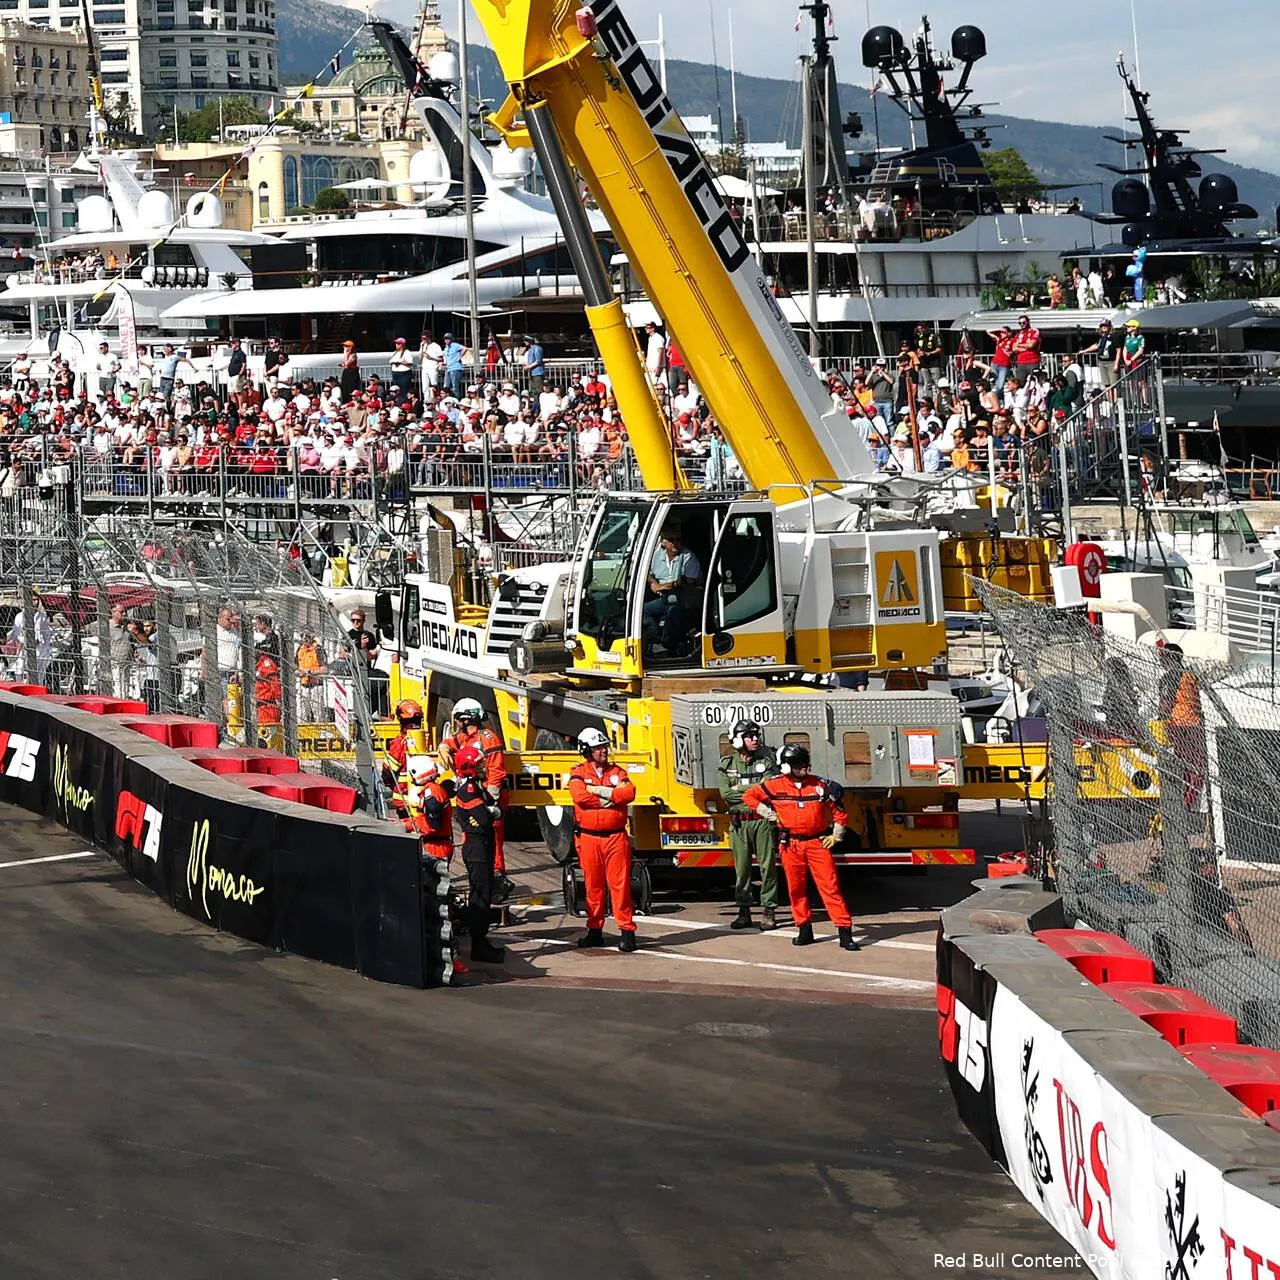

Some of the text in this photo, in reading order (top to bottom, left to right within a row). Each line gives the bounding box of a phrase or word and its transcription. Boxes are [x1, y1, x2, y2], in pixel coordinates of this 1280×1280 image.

[705, 706, 722, 724] 60
[730, 706, 745, 721] 70
[753, 705, 771, 723] 80
[5, 733, 41, 782] 75
[187, 818, 265, 919] Monaco
